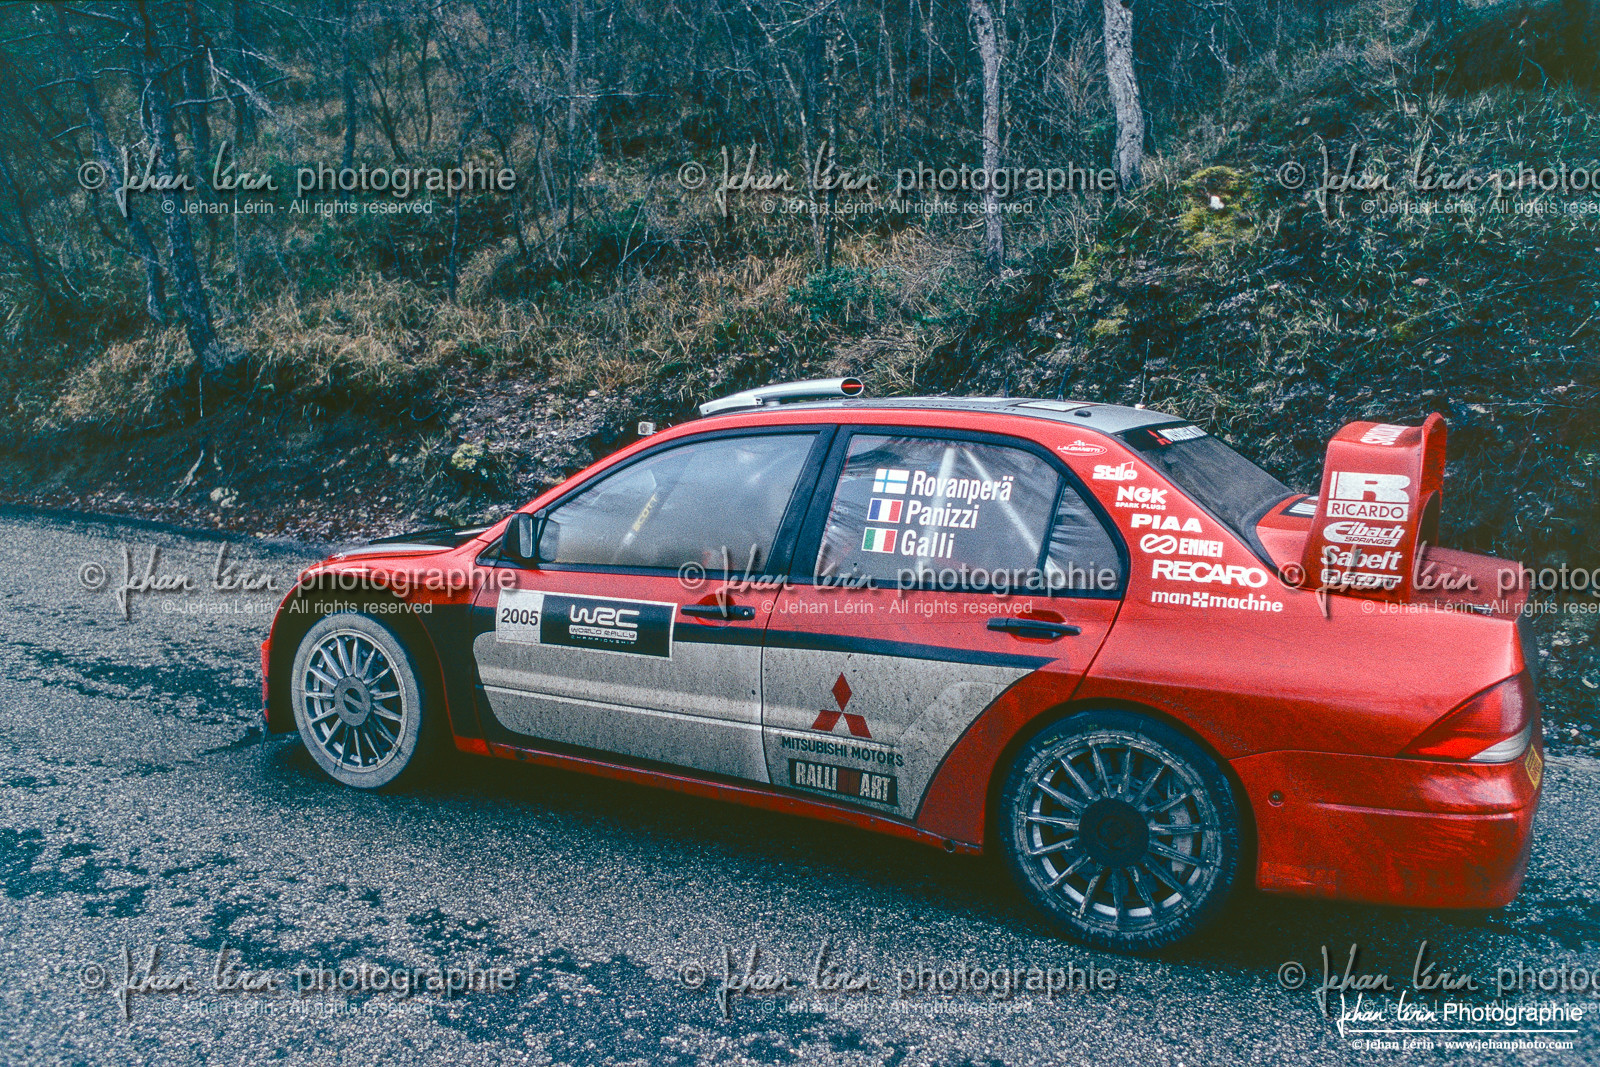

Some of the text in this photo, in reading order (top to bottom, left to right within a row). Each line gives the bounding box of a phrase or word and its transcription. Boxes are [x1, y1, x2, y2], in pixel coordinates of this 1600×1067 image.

[1092, 461, 1138, 481] Stilo
[911, 470, 1014, 505] Rovanperä
[1117, 486, 1168, 505] NGK
[905, 500, 980, 529] Panizzi
[1115, 502, 1139, 510] SPARK
[1331, 503, 1404, 519] RICARDO
[1131, 514, 1203, 533] PIAA
[1323, 520, 1406, 541] Eibach
[901, 529, 955, 558] Galli
[1178, 538, 1223, 558] ENKEI
[1344, 536, 1392, 545] SPRINGS
[1321, 545, 1403, 570] Sabelt
[1151, 559, 1269, 588] RECARO
[501, 608, 539, 626] 2005
[570, 604, 640, 628] WRC
[570, 635, 636, 645] CHAMPIONSHIP
[571, 627, 636, 639] WORLD RALLY
[781, 736, 904, 767] MITSUBISHI MOTORS
[795, 761, 891, 801] RALLI ART
